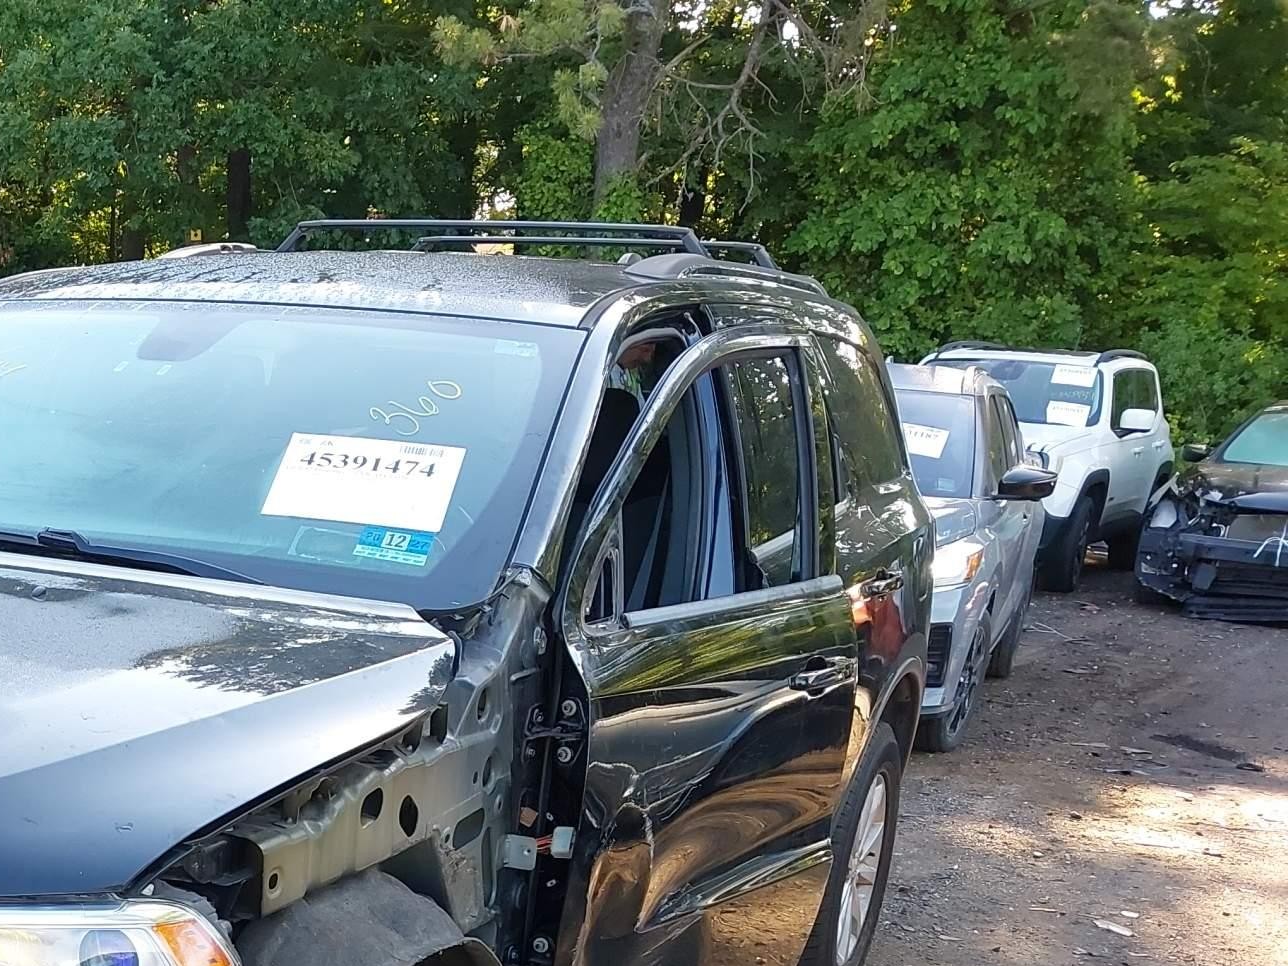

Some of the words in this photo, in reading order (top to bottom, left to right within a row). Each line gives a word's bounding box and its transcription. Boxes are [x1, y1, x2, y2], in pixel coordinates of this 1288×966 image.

[369, 379, 462, 436] 360
[300, 451, 436, 477] 45391474
[385, 532, 408, 549] 12
